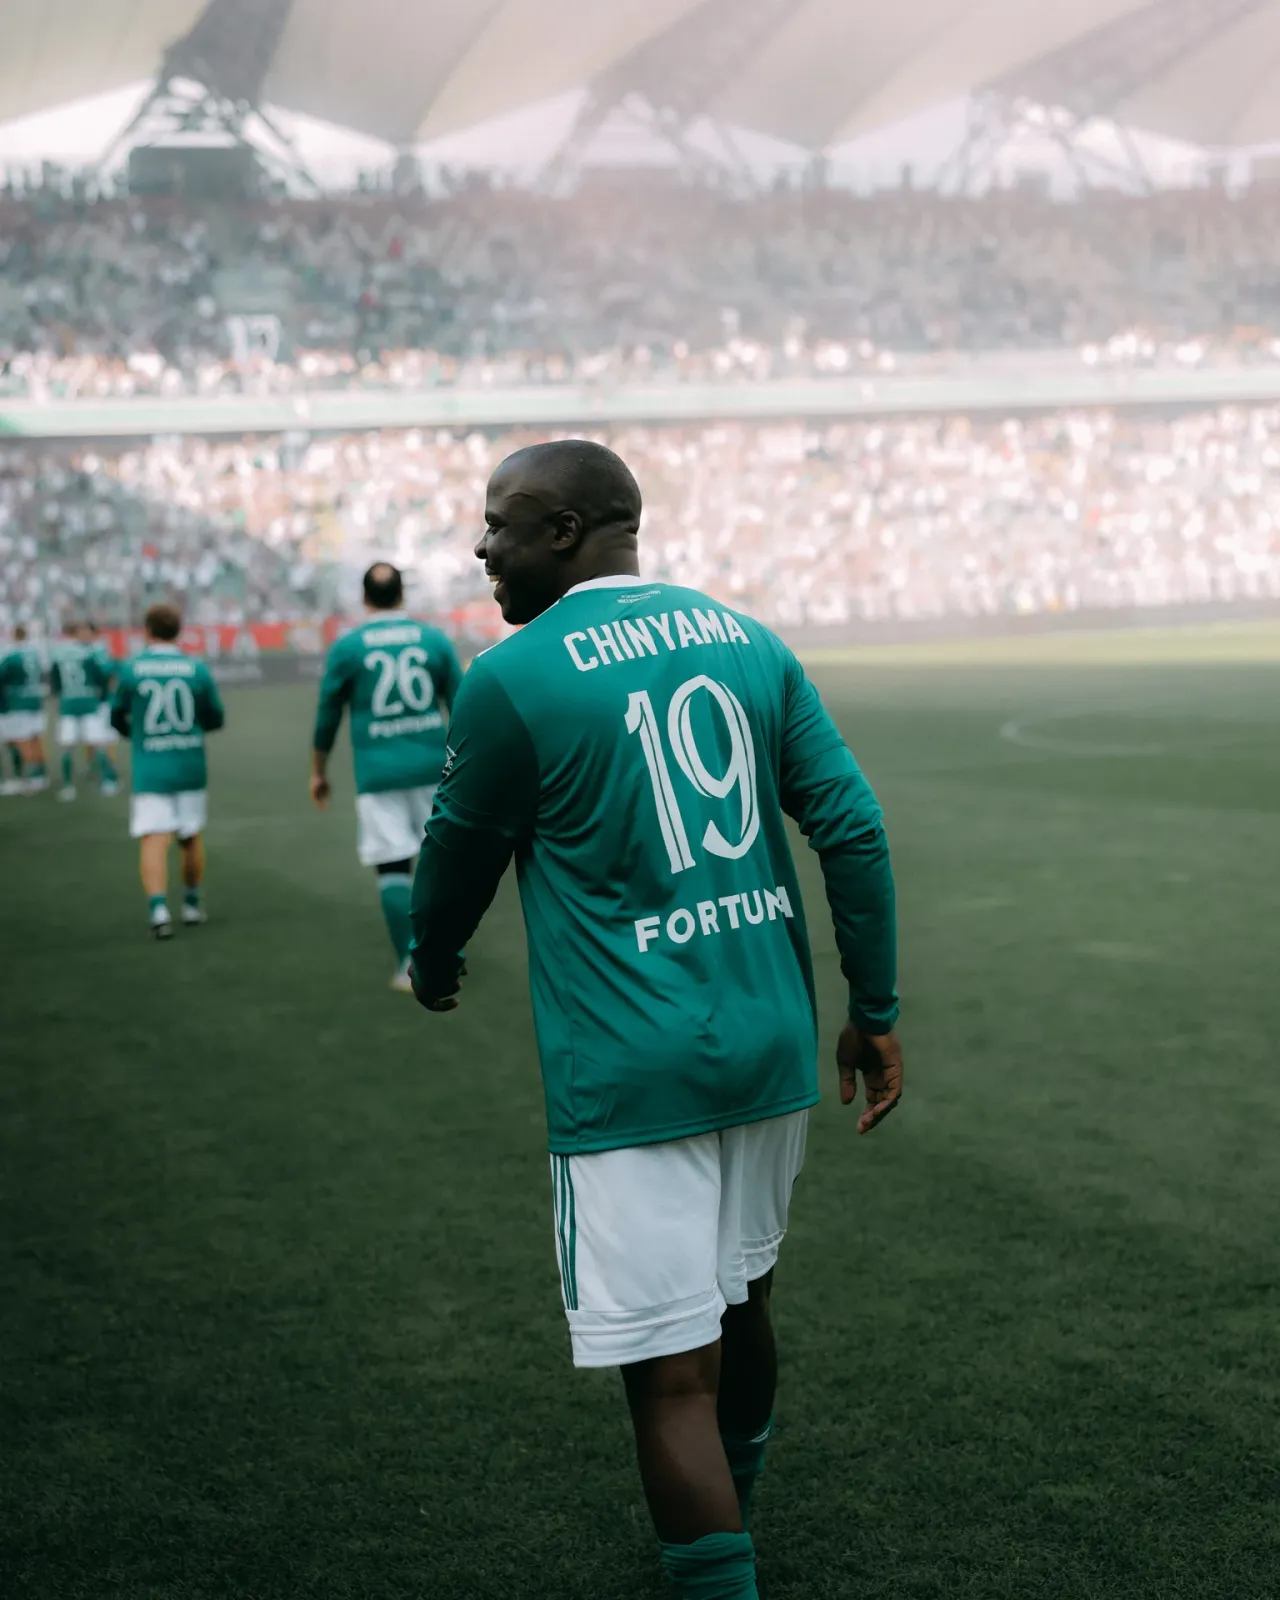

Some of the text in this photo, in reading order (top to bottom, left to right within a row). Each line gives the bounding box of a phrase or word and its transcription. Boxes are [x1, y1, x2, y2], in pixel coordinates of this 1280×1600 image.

[563, 608, 750, 671] CHINYAMA
[137, 678, 195, 735] 20
[363, 646, 434, 718] 26
[624, 675, 760, 874] 19
